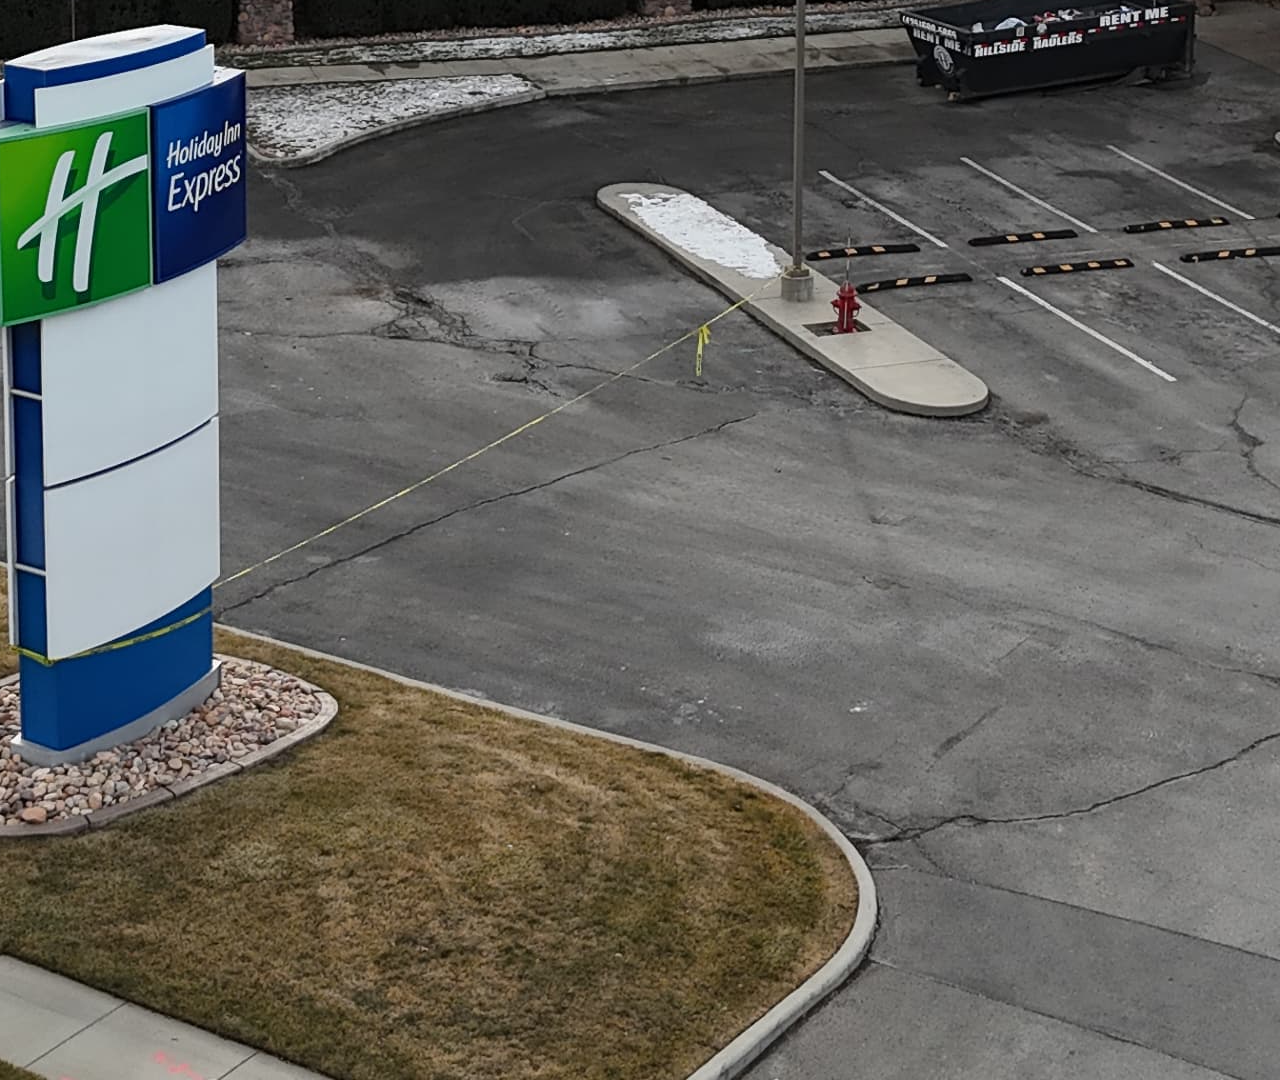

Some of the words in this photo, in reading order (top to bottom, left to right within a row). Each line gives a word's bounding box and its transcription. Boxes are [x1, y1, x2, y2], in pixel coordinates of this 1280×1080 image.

[1100, 10, 1142, 27] RENT
[1145, 6, 1169, 20] ME
[974, 40, 1026, 58] HILLSIDE
[1032, 32, 1083, 50] HAULERS
[166, 130, 223, 169] Holiday
[223, 120, 241, 147] Inn
[167, 155, 241, 212] Express
